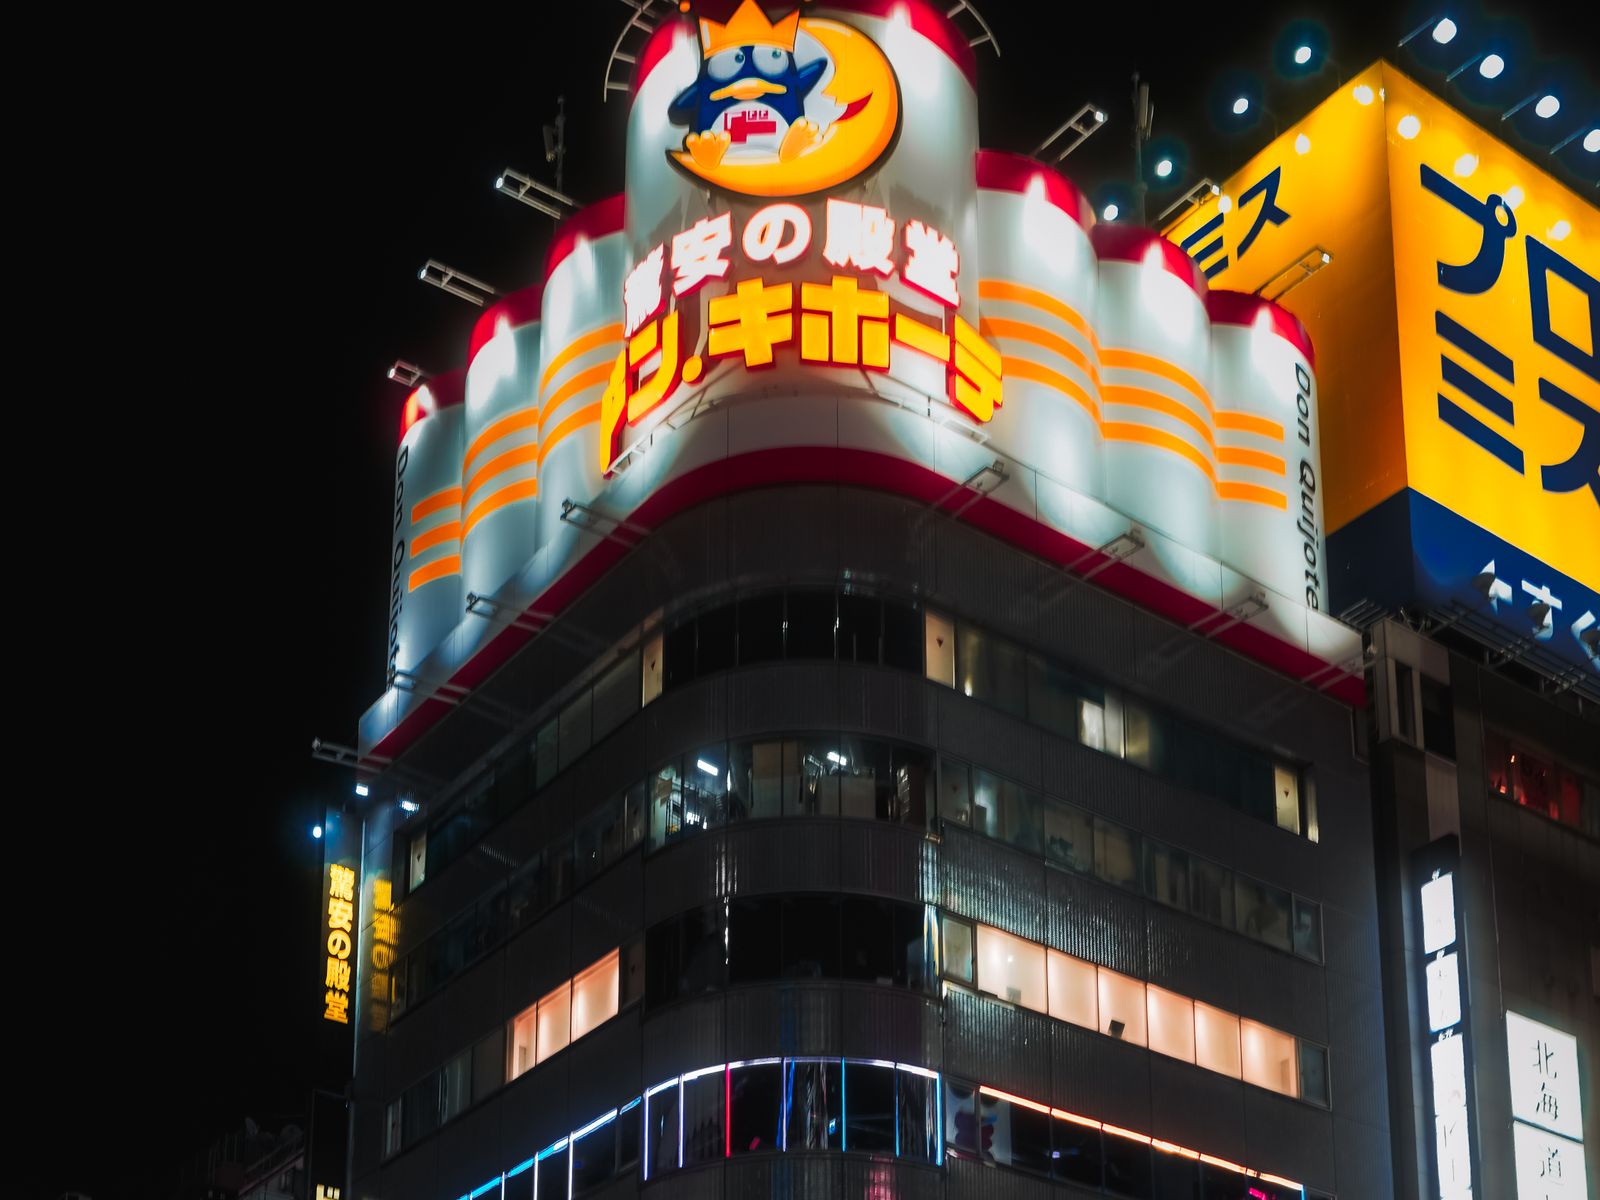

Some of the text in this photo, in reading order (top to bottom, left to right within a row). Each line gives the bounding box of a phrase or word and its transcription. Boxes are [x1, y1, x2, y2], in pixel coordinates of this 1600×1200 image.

[623, 197, 960, 337] 驚安の殿堂
[395, 446, 408, 530] Don
[1294, 361, 1318, 611] Don Quijote
[324, 863, 355, 1025] 驚安の殿堂
